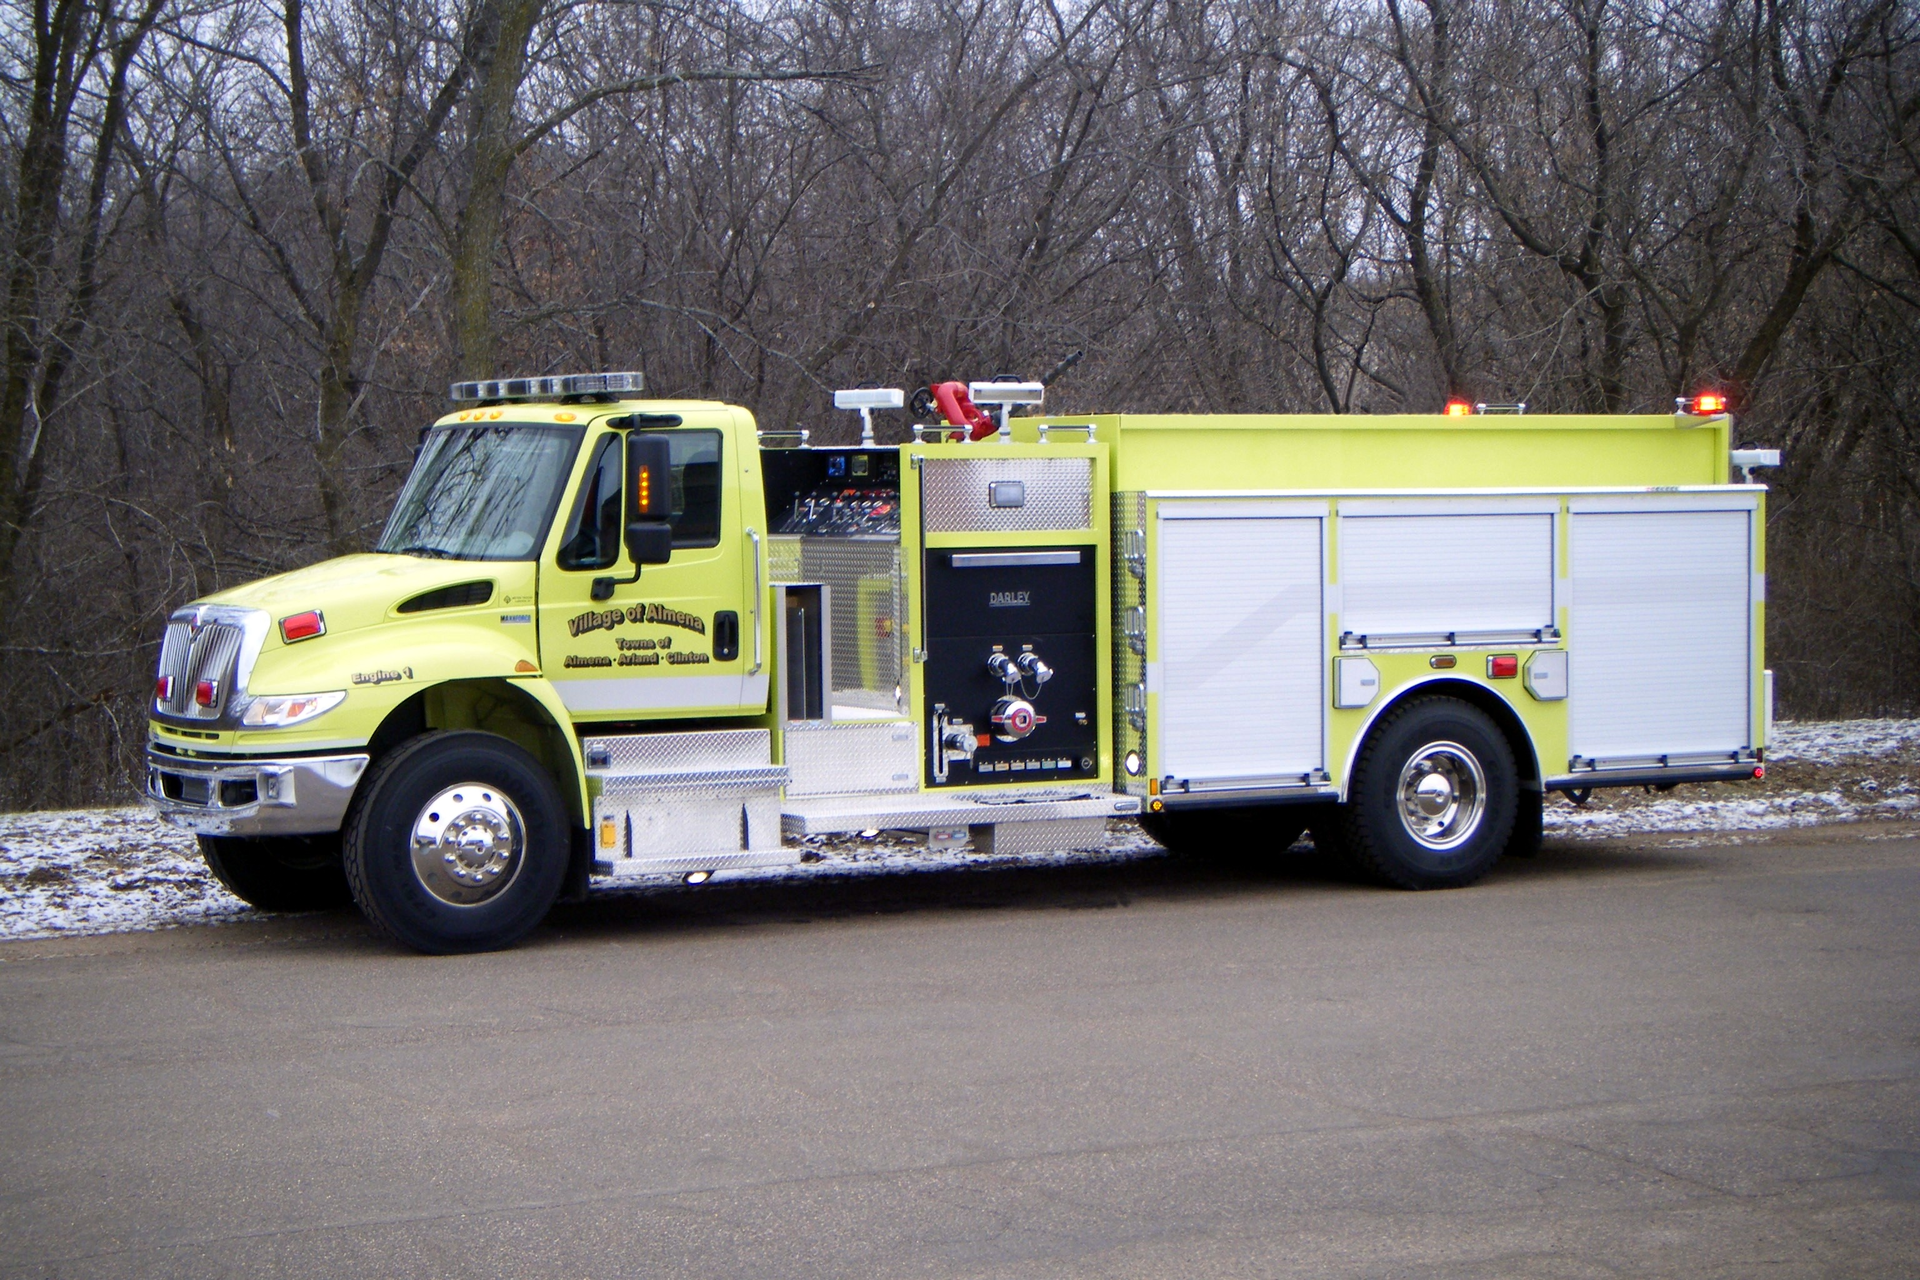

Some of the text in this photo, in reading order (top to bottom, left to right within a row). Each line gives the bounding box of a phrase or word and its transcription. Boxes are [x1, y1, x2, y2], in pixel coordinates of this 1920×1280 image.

[990, 591, 1030, 604] DARLEY
[568, 603, 705, 637] Village of Almena
[615, 636, 672, 650] Towns of
[564, 651, 709, 668] Almena Arland Clinton
[351, 666, 413, 685] Engine 1
